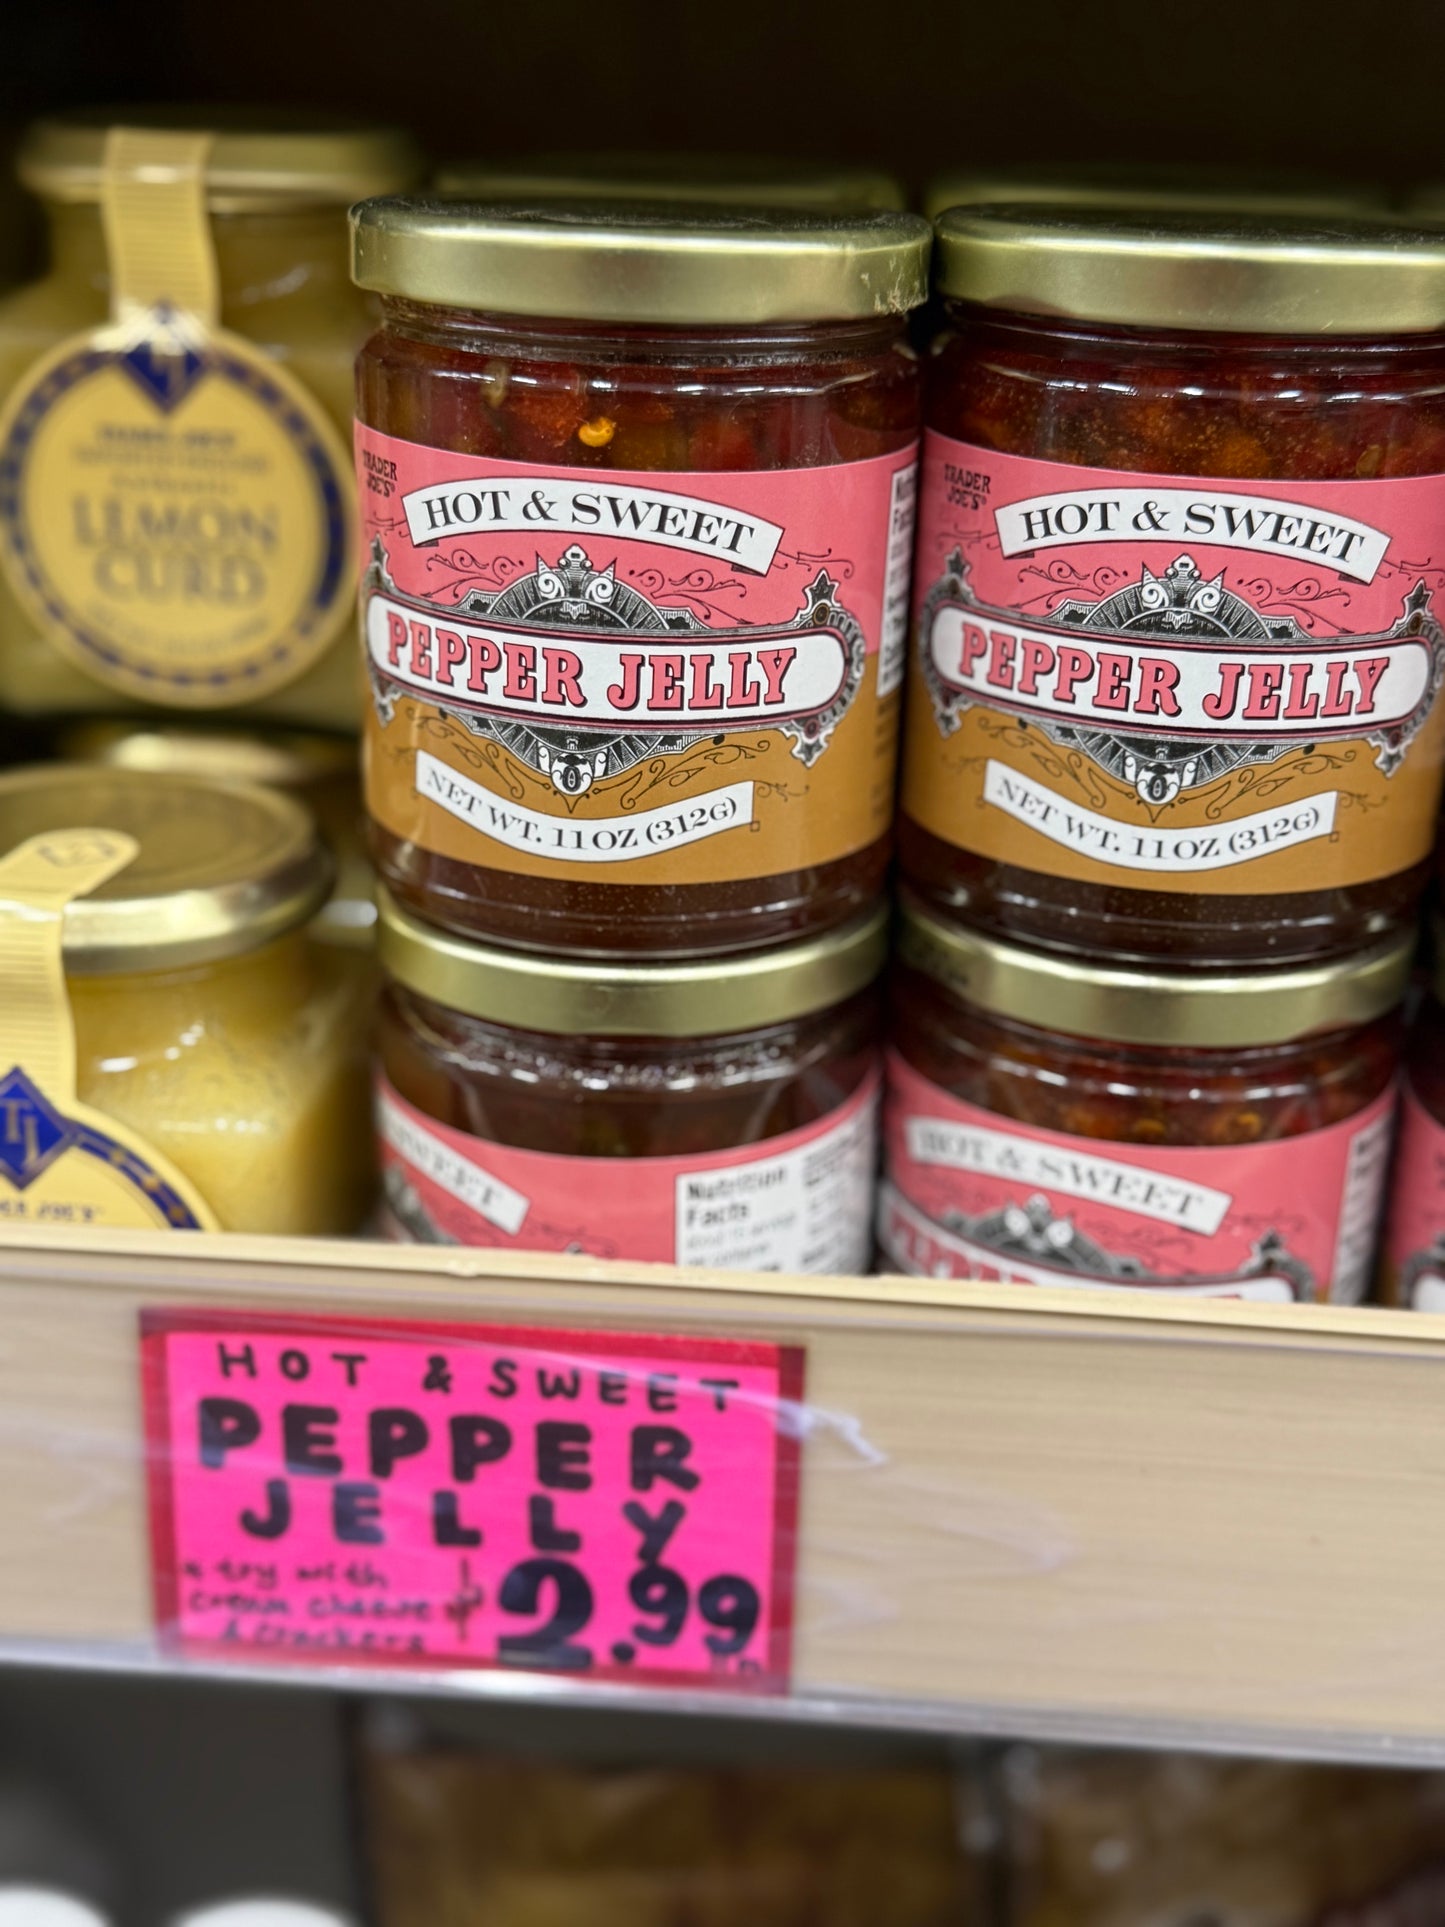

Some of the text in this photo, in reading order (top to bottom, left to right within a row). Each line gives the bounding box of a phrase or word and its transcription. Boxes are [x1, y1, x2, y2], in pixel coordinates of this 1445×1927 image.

[364, 449, 398, 482] TRADER
[944, 463, 991, 494] TRADER
[421, 489, 756, 555] HOT & SWEET
[1018, 500, 1366, 564] HOT & SWEET
[386, 611, 798, 712] PEPPER JELLY
[958, 620, 1391, 721] PEPPER JELLY
[425, 769, 484, 818] NET
[485, 809, 543, 844] WT.
[645, 796, 738, 846] (312G)
[996, 776, 1060, 823] NET
[1062, 816, 1121, 853] WT.
[1228, 806, 1321, 855] (312G)
[687, 1164, 786, 1200] Nutrition
[917, 1127, 1205, 1218] HOT & SWEET
[217, 1341, 741, 1412] HOT & SWEET
[198, 1396, 701, 1493] PEPPER
[240, 1478, 687, 1566] JELLY
